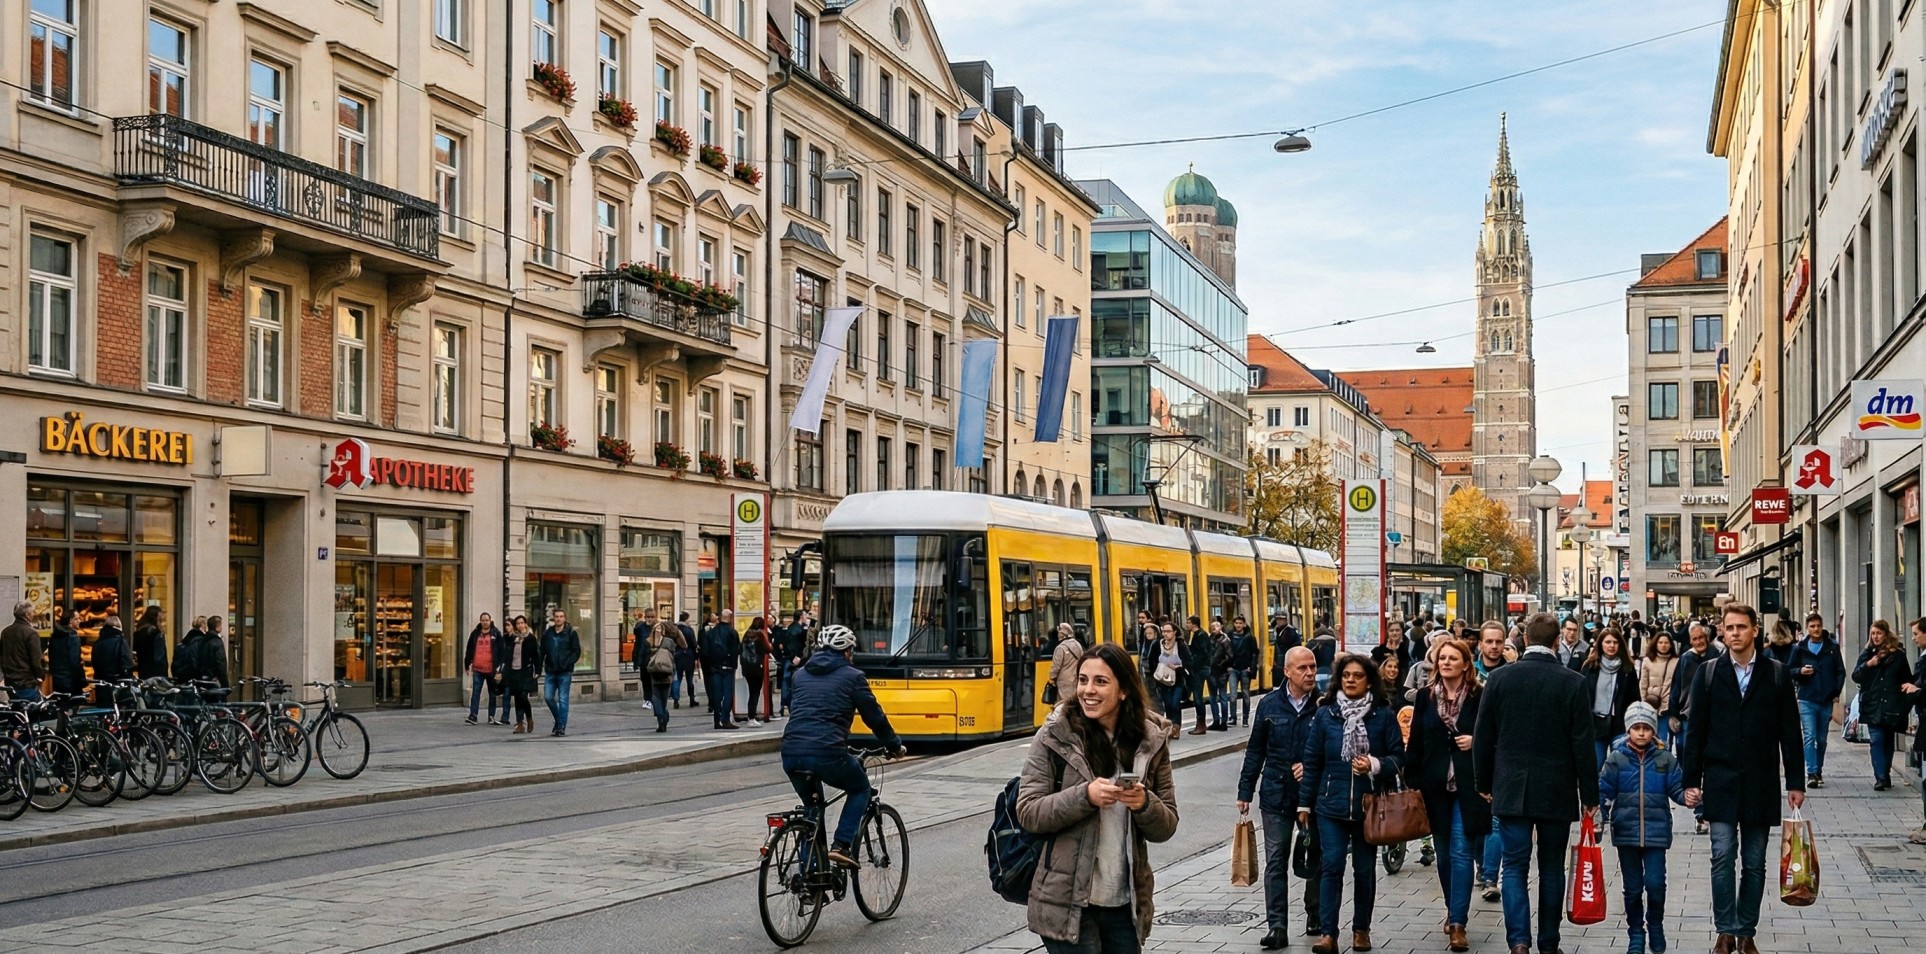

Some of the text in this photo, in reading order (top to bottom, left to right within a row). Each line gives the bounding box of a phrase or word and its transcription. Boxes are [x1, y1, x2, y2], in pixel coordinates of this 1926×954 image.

[1867, 387, 1914, 415] dm
[43, 411, 194, 464] BÄCKEREI
[369, 457, 475, 493] APOTHEKE
[1356, 491, 1369, 507] H
[1754, 499, 1786, 510] REWE
[743, 504, 755, 519] H
